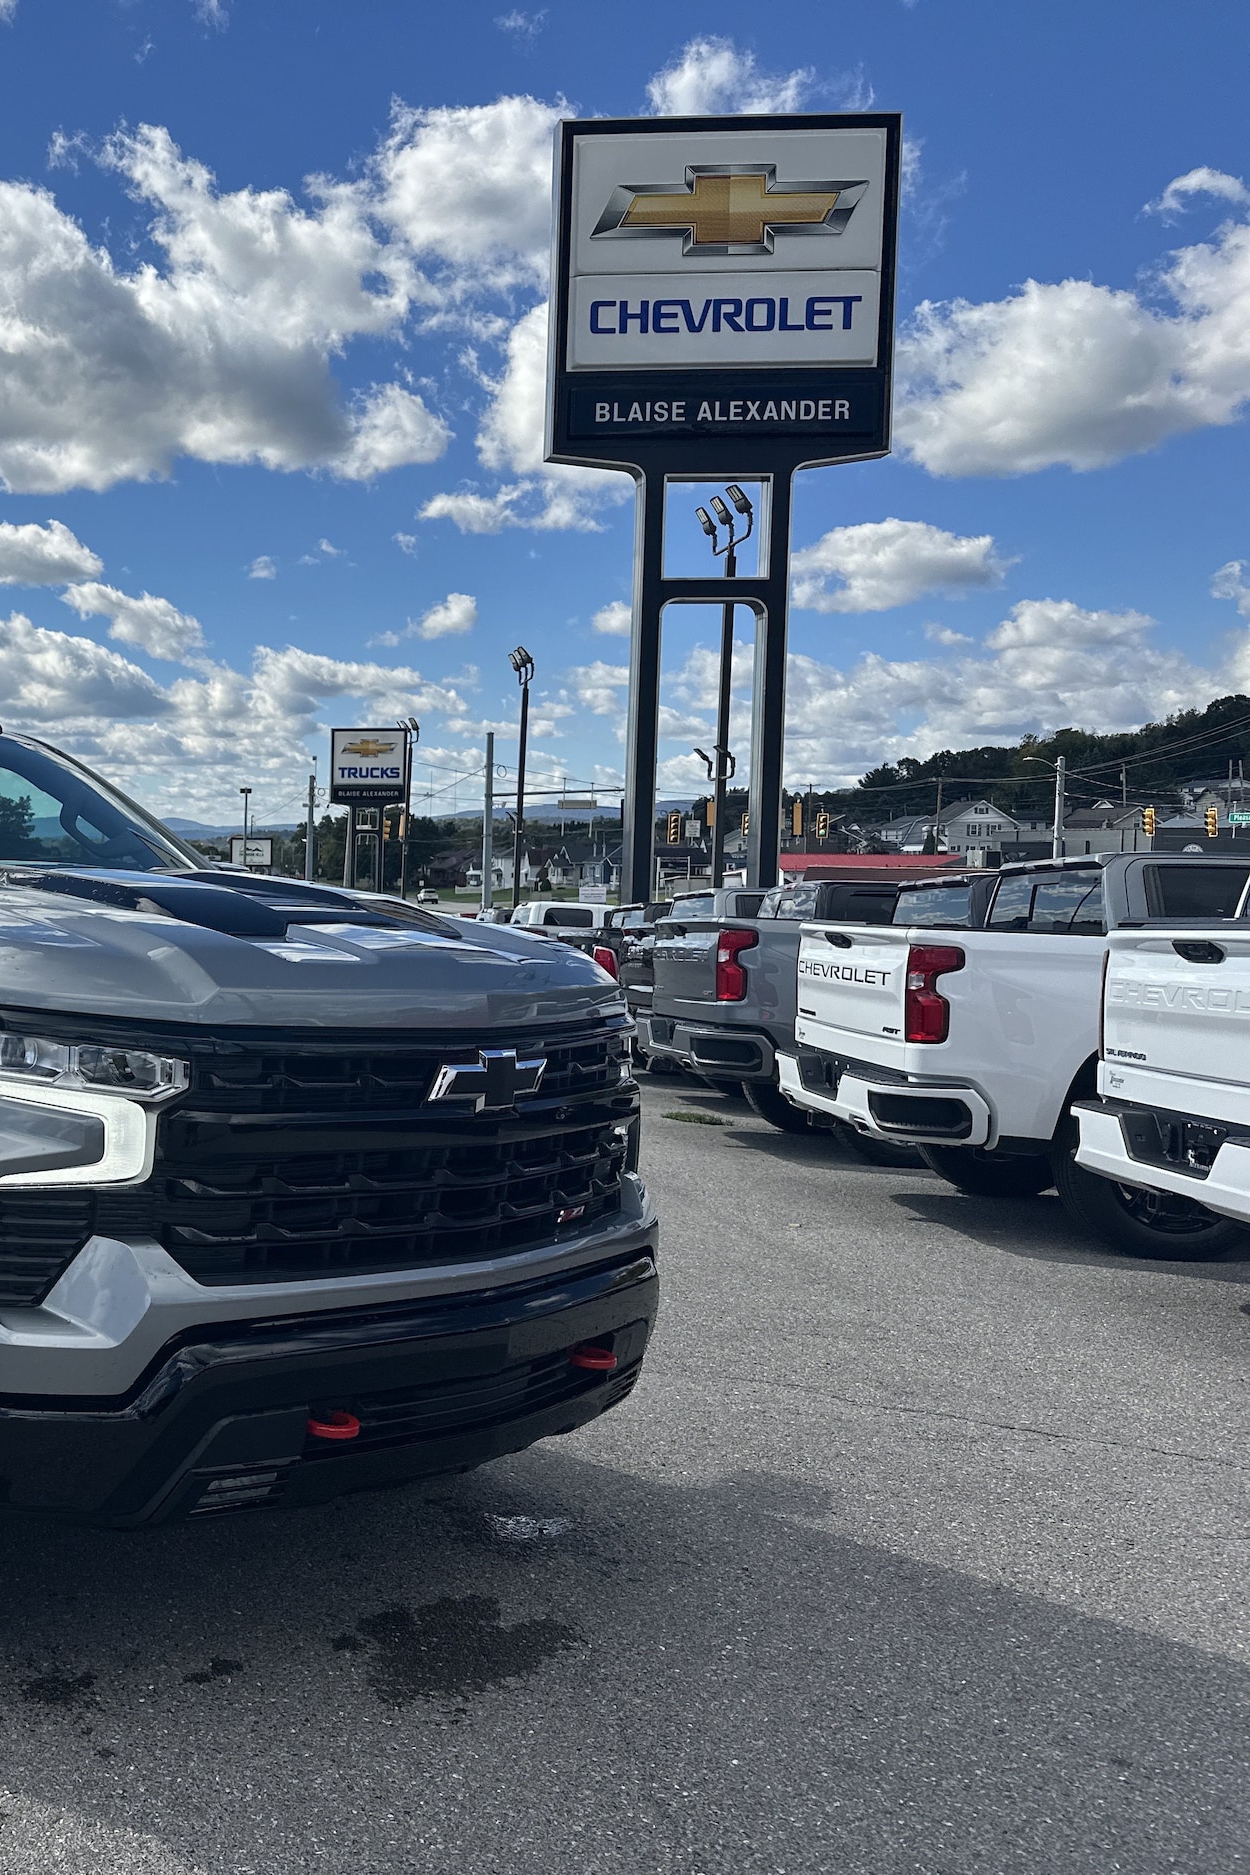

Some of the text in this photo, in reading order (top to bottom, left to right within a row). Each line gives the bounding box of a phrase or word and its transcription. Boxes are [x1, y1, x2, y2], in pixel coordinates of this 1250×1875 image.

[589, 295, 863, 334] CHEVROLET
[594, 399, 851, 423] BLAISE ALEXANDER
[338, 767, 400, 779] TRUCKS
[798, 960, 892, 986] CHEVROLET
[882, 1026, 901, 1034] RST
